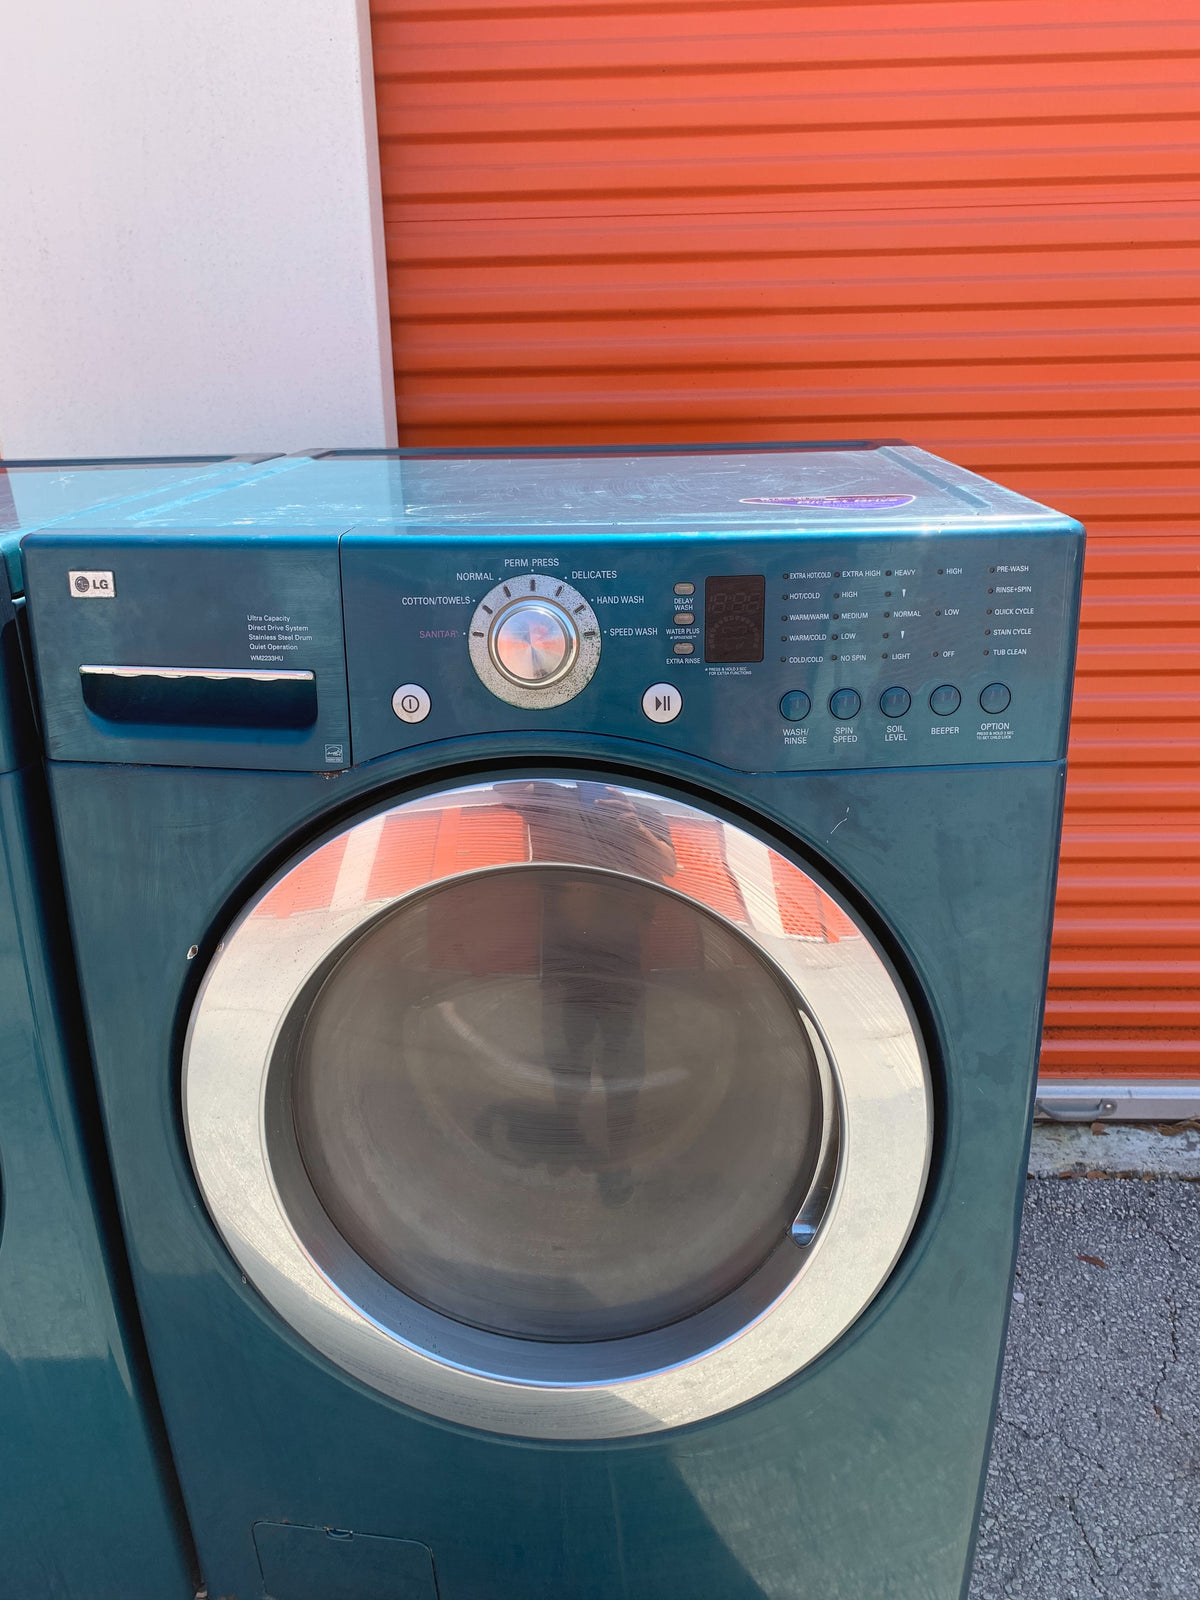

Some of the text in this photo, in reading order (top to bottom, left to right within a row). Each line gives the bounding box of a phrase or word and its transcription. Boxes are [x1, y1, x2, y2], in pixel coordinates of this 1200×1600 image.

[504, 558, 560, 567] PERM PRESS
[996, 565, 1029, 573] PRE-WASH
[456, 572, 494, 581] NORMAL
[571, 570, 618, 579] DELICATES
[806, 571, 832, 579] HOT/COLD
[92, 579, 109, 590] LG
[596, 595, 645, 605] HAND WASH
[789, 592, 820, 600] HOT/COLD
[401, 596, 471, 606] COTTON/TOWELS
[673, 597, 694, 605] DELAY
[893, 610, 922, 618] NORMAL
[994, 607, 1034, 616] QUICK CYCLE
[263, 614, 290, 623] Capacity
[789, 613, 830, 621] WARM/WARM
[285, 625, 309, 633] System
[609, 626, 658, 637] SPEED WASH
[686, 627, 700, 635] PLUS
[993, 628, 1012, 636] STAIN
[248, 633, 277, 641] Stainless
[419, 630, 459, 639] SANITAR
[789, 634, 827, 642] WARM/COLD
[249, 643, 299, 652] Quiet Operation
[942, 650, 955, 658] OFF
[1006, 648, 1027, 656] CLEAN
[788, 656, 824, 664] COLD/COLD
[852, 654, 867, 662] SPIN
[891, 653, 911, 661] LIGHT
[886, 725, 904, 733] SOIL
[930, 726, 960, 735] BEEPER
[980, 722, 1010, 731] OPTION
[782, 727, 809, 737] WASH/
[835, 727, 854, 735] SPIN
[784, 736, 808, 745] RINSE
[832, 735, 858, 744] SPEED
[884, 733, 908, 742] LEVEL
